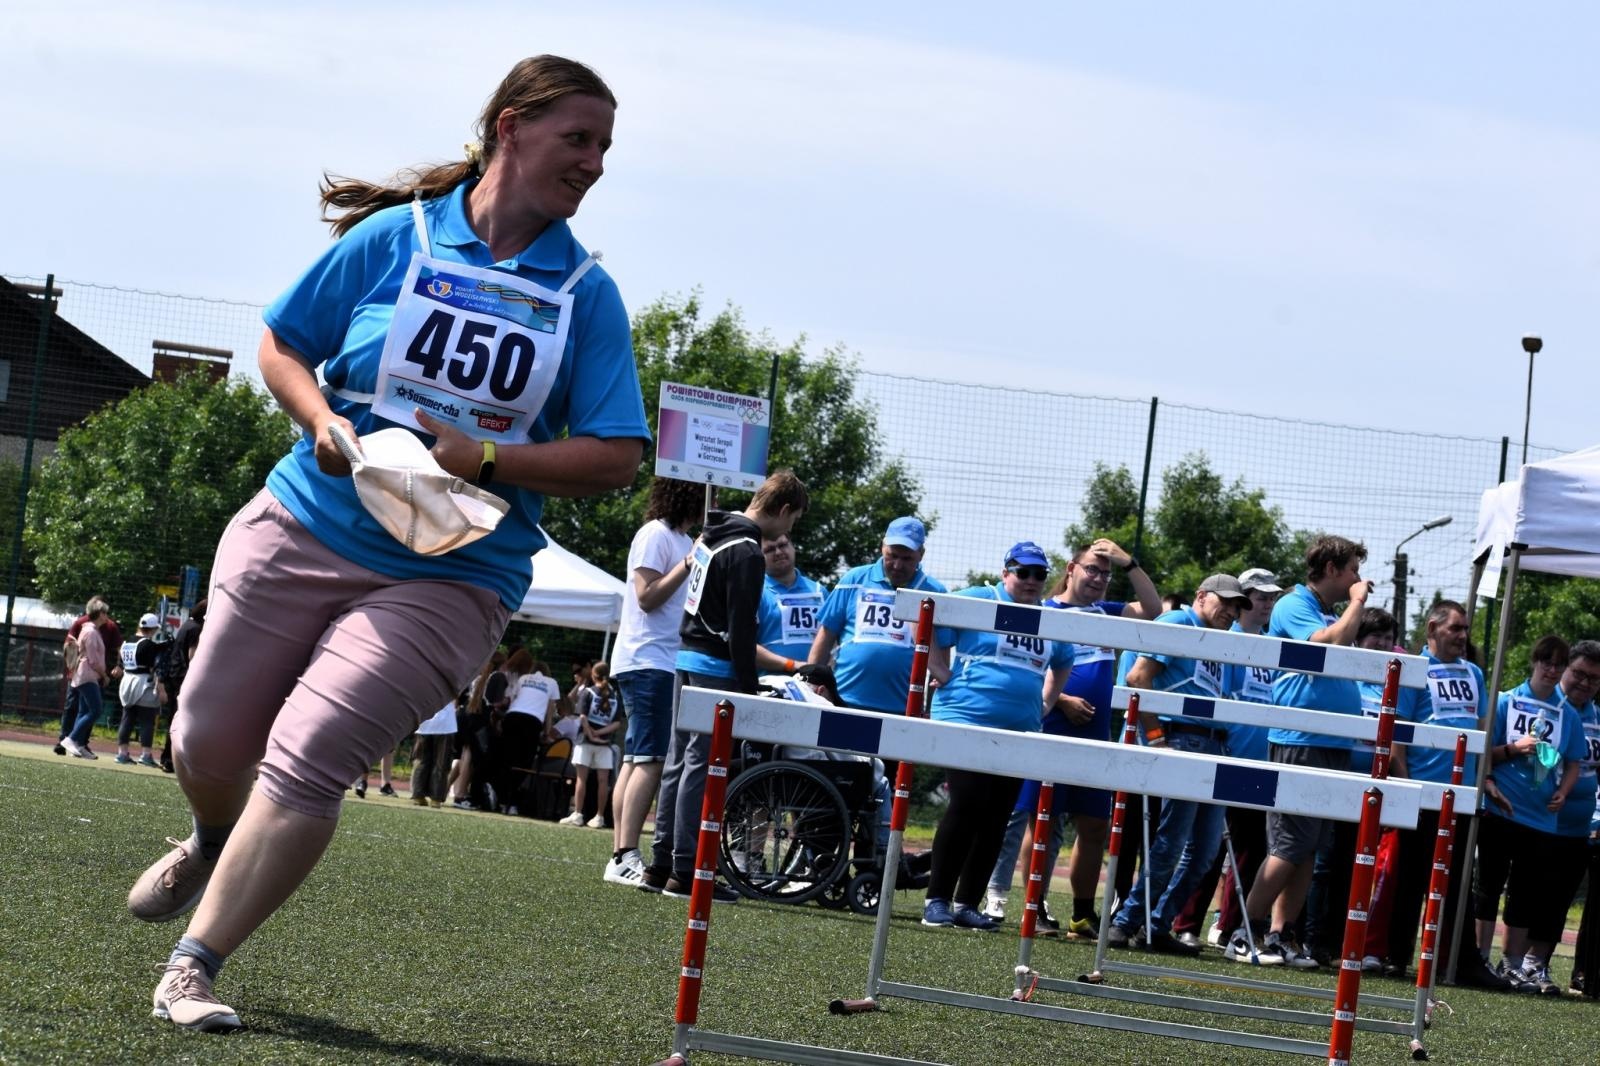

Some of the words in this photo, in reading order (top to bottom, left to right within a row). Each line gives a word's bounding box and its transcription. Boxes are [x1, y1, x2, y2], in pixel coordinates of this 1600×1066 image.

[405, 309, 536, 402] 450
[407, 388, 461, 418] Summer-cha
[666, 385, 715, 399] POWIATOWA
[717, 393, 758, 409] OLIMPIADA
[480, 417, 507, 430] EFEKT
[1006, 634, 1045, 656] 440
[1252, 667, 1272, 685] 45
[1437, 680, 1475, 701] 448
